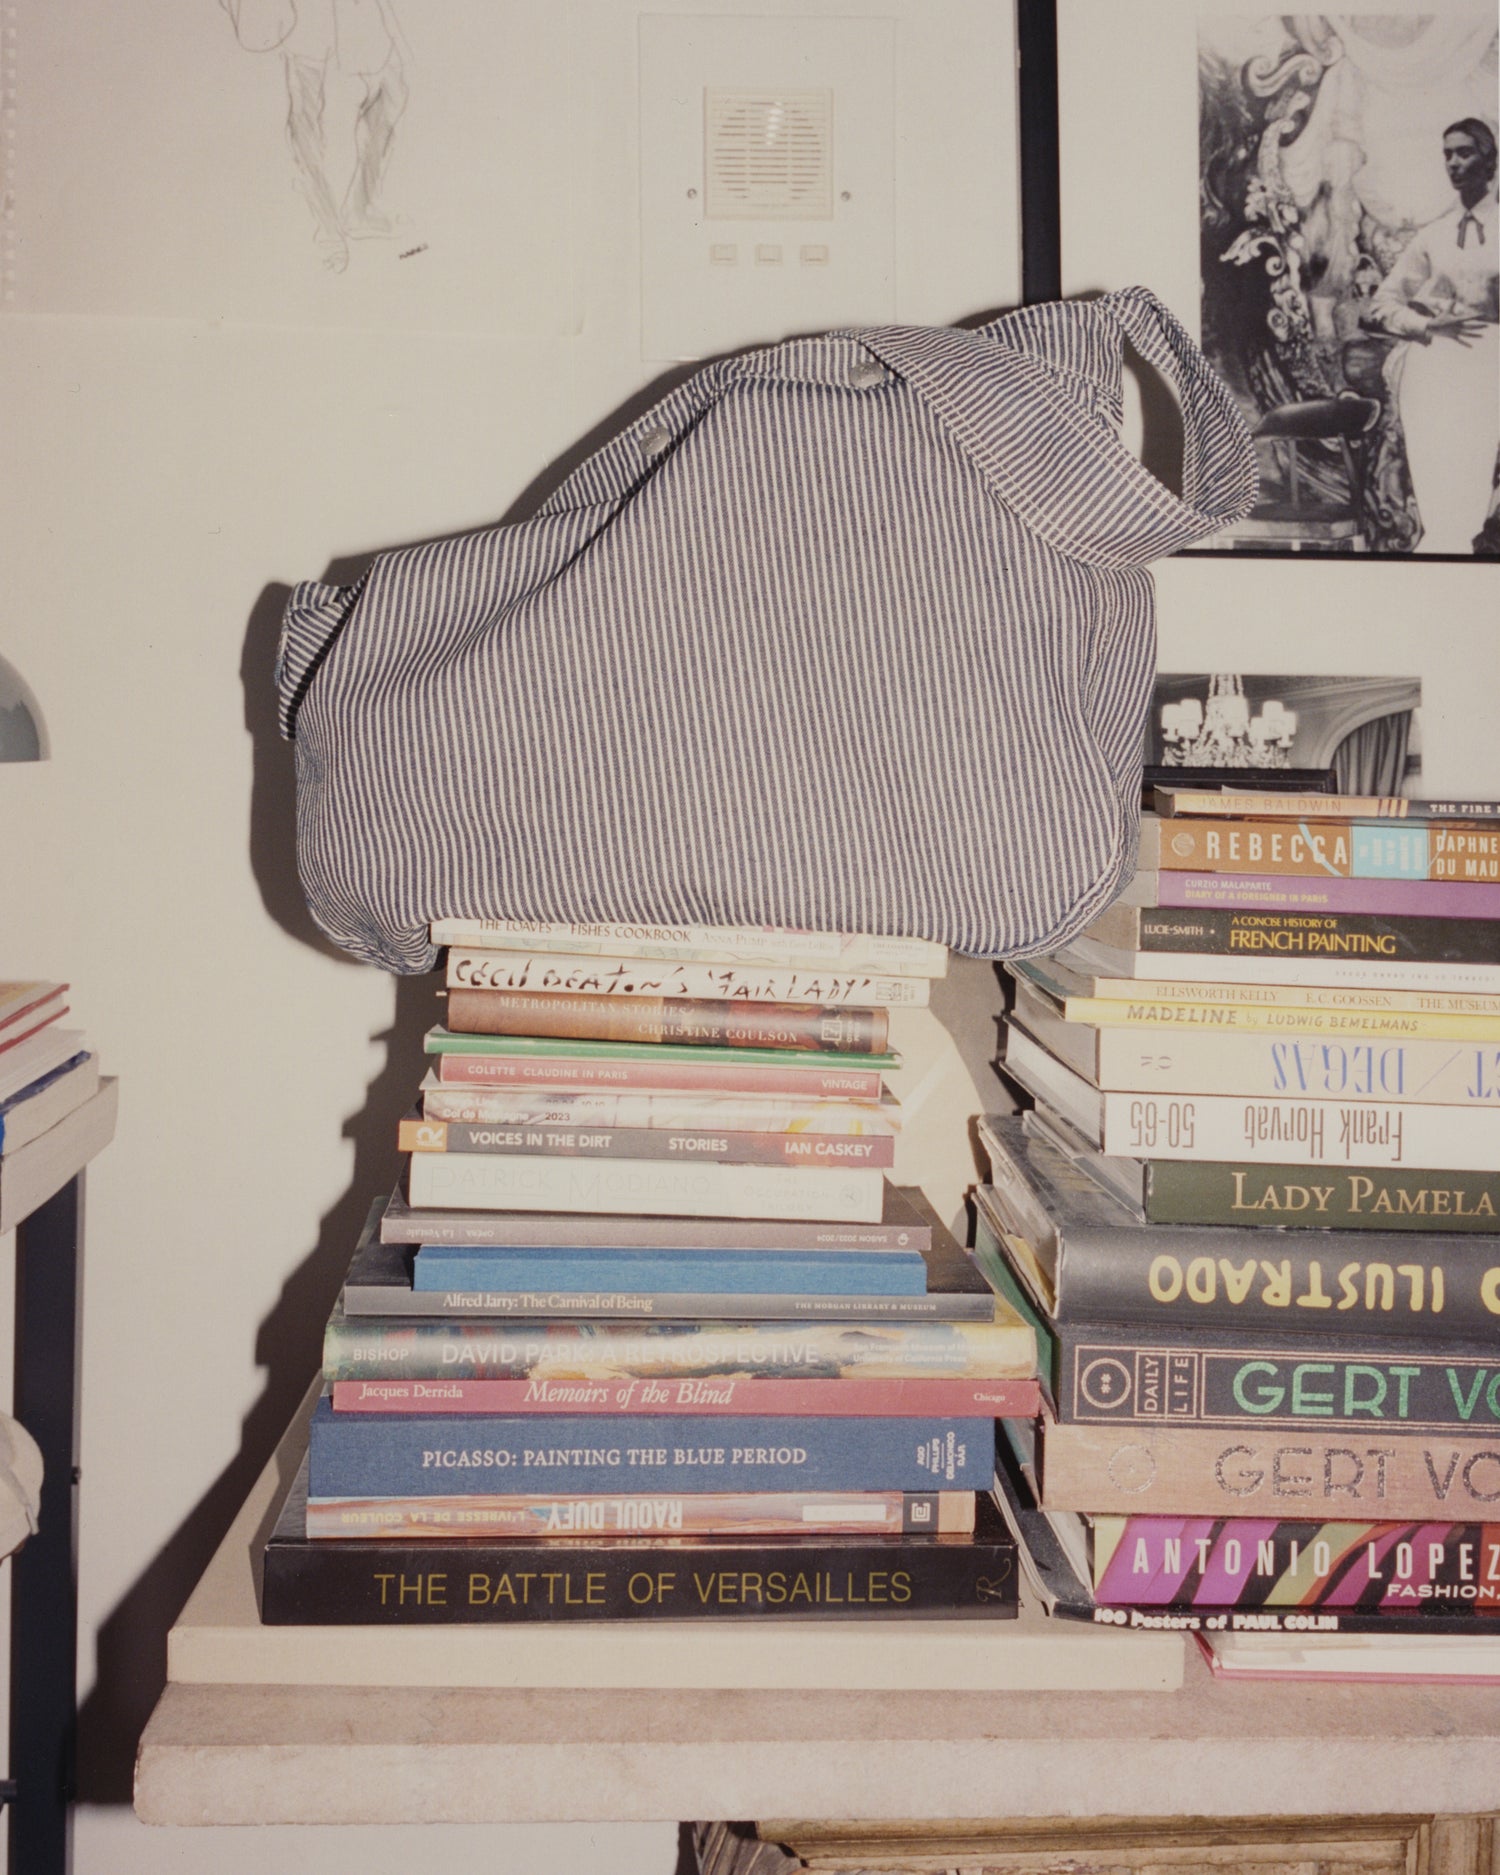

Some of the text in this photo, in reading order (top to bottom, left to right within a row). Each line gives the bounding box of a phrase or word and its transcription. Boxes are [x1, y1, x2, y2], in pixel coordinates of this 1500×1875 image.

[1203, 797, 1342, 812] JAMES BALDWIN
[1430, 803, 1491, 814] THE FIRE
[1206, 830, 1348, 865] REBECCA
[1436, 834, 1498, 854] DAPHNE
[1436, 858, 1456, 876] DU
[1185, 879, 1272, 891] CURZIO MALAPARTE
[1185, 890, 1328, 903] DIARY OF A FOREIGNER IN PARIS
[479, 919, 500, 931] THE
[505, 920, 552, 934] LOAVES
[570, 923, 611, 938] FISHES
[614, 927, 692, 943] COOKBOOK
[1144, 924, 1204, 936] LUCIE-SMITH
[1231, 917, 1338, 929] A CONCISE HISTORY OF
[1230, 930, 1396, 954] FRENCH PAINTING
[1156, 986, 1278, 1001] ELLSWORTH KELLY
[1333, 995, 1392, 1007] GOOSSEN
[1418, 997, 1443, 1009] THE
[499, 996, 687, 1018] METROPOLITAN STORIES
[1127, 1005, 1419, 1031] MADELINE by LUDWIG BEMELMANS
[638, 1023, 798, 1043] CHRISTINE COULSON
[467, 1065, 628, 1081] COLETTE CLAUDINE IN PARIS
[1271, 1041, 1407, 1096] DEGAS
[821, 1078, 868, 1091] VINTAGE
[545, 1112, 571, 1121] 2023
[468, 1130, 612, 1149] VOICES IN THE DIRT
[1130, 1100, 1403, 1161] Frank Horvat 50-65
[668, 1136, 729, 1153] STORIES
[784, 1141, 873, 1158] IAN CASKEY
[431, 1165, 713, 1209] PATRICK MODIANO
[859, 1234, 888, 1243] SAISON
[1148, 1254, 1445, 1313] ILUSTRADO
[443, 1293, 654, 1312] Alfred Jarry: The Carnival of Being
[794, 1302, 937, 1312] THE MORGAN LIBRARY & MUSEUM
[353, 1349, 409, 1361] BISHOP
[441, 1343, 820, 1364] DAVID PARK: A RETROSPECTIVE
[358, 1383, 464, 1401] Jacques Derrida
[523, 1380, 736, 1409] Memoirs of the Blind
[1143, 1357, 1160, 1413] DAILY
[1173, 1356, 1189, 1414] LIFE
[1232, 1360, 1421, 1419] GERT
[973, 1392, 1006, 1404] Chicago
[422, 1447, 808, 1468] PICASSO: PAINTING THE BLUE PERIOD
[931, 1437, 941, 1474] PHILLIPS
[945, 1431, 956, 1481] DELMONICO
[1213, 1443, 1396, 1499] GERT
[341, 1500, 684, 1531] RAOUL DUFY L'IVRESSE DE LA COULEUR
[1132, 1536, 1500, 1581] ANTONIO LOPEZ
[373, 1570, 913, 1606] THE BATTLE OF VERSAILLES
[1093, 1608, 1339, 1631] 100 Posters of PAUL COLIN
